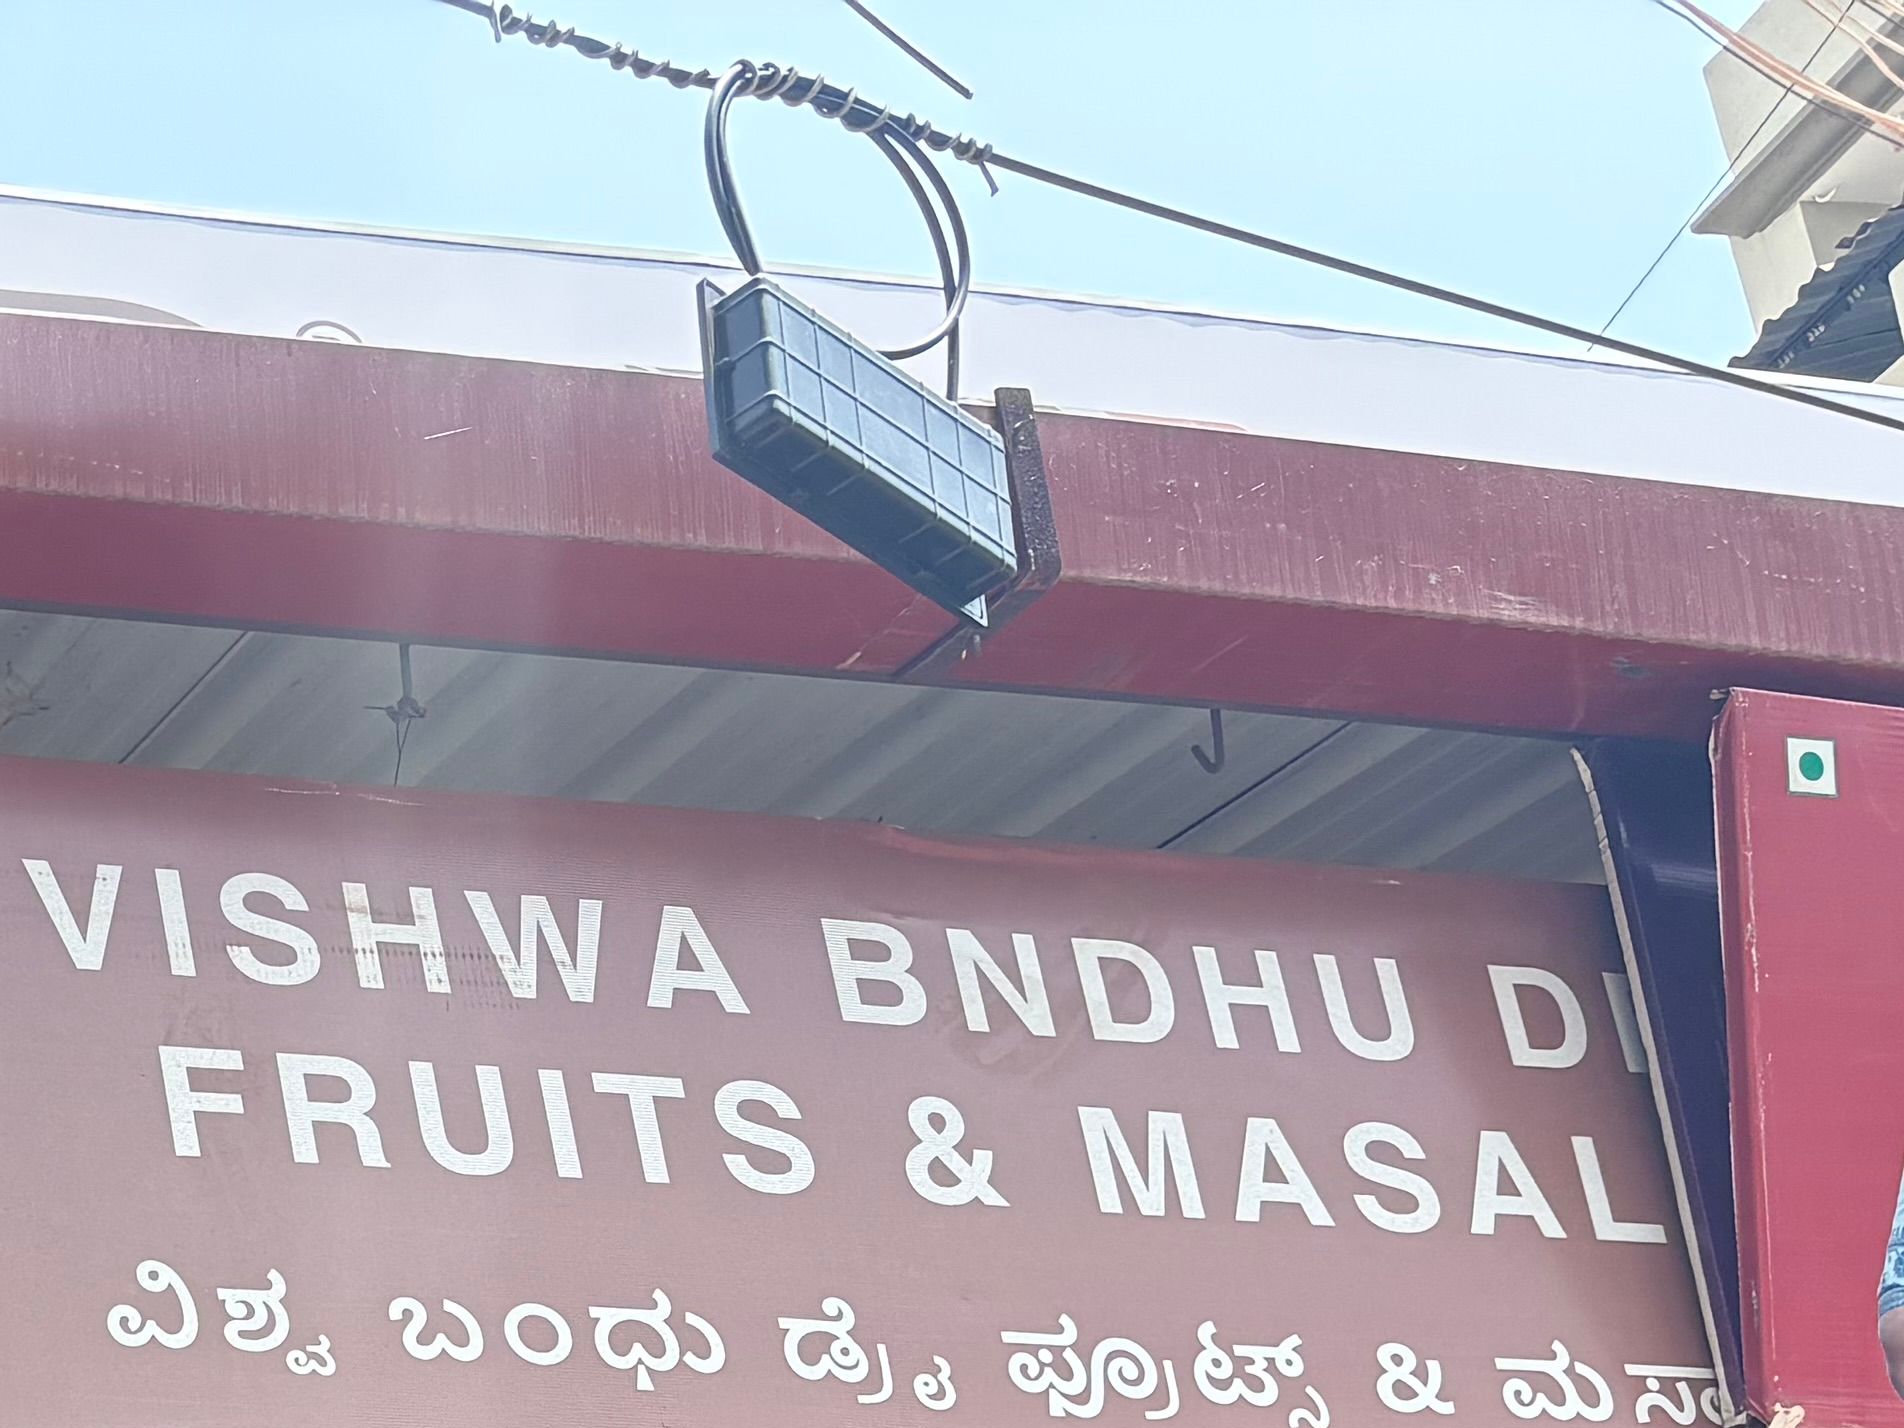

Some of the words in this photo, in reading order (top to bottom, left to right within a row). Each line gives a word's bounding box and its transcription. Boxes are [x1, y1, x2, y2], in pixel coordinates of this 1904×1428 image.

[22, 857, 749, 1015] VISHWA
[819, 915, 1418, 1066] BNDHU
[156, 1040, 817, 1196] FRUITS
[903, 1094, 1012, 1209] &
[1075, 1105, 1669, 1248] MASAL
[104, 1256, 339, 1381] ವಿಶ್ವ
[385, 1287, 726, 1393] ಬಂಧು
[1376, 1335, 1456, 1413] &
